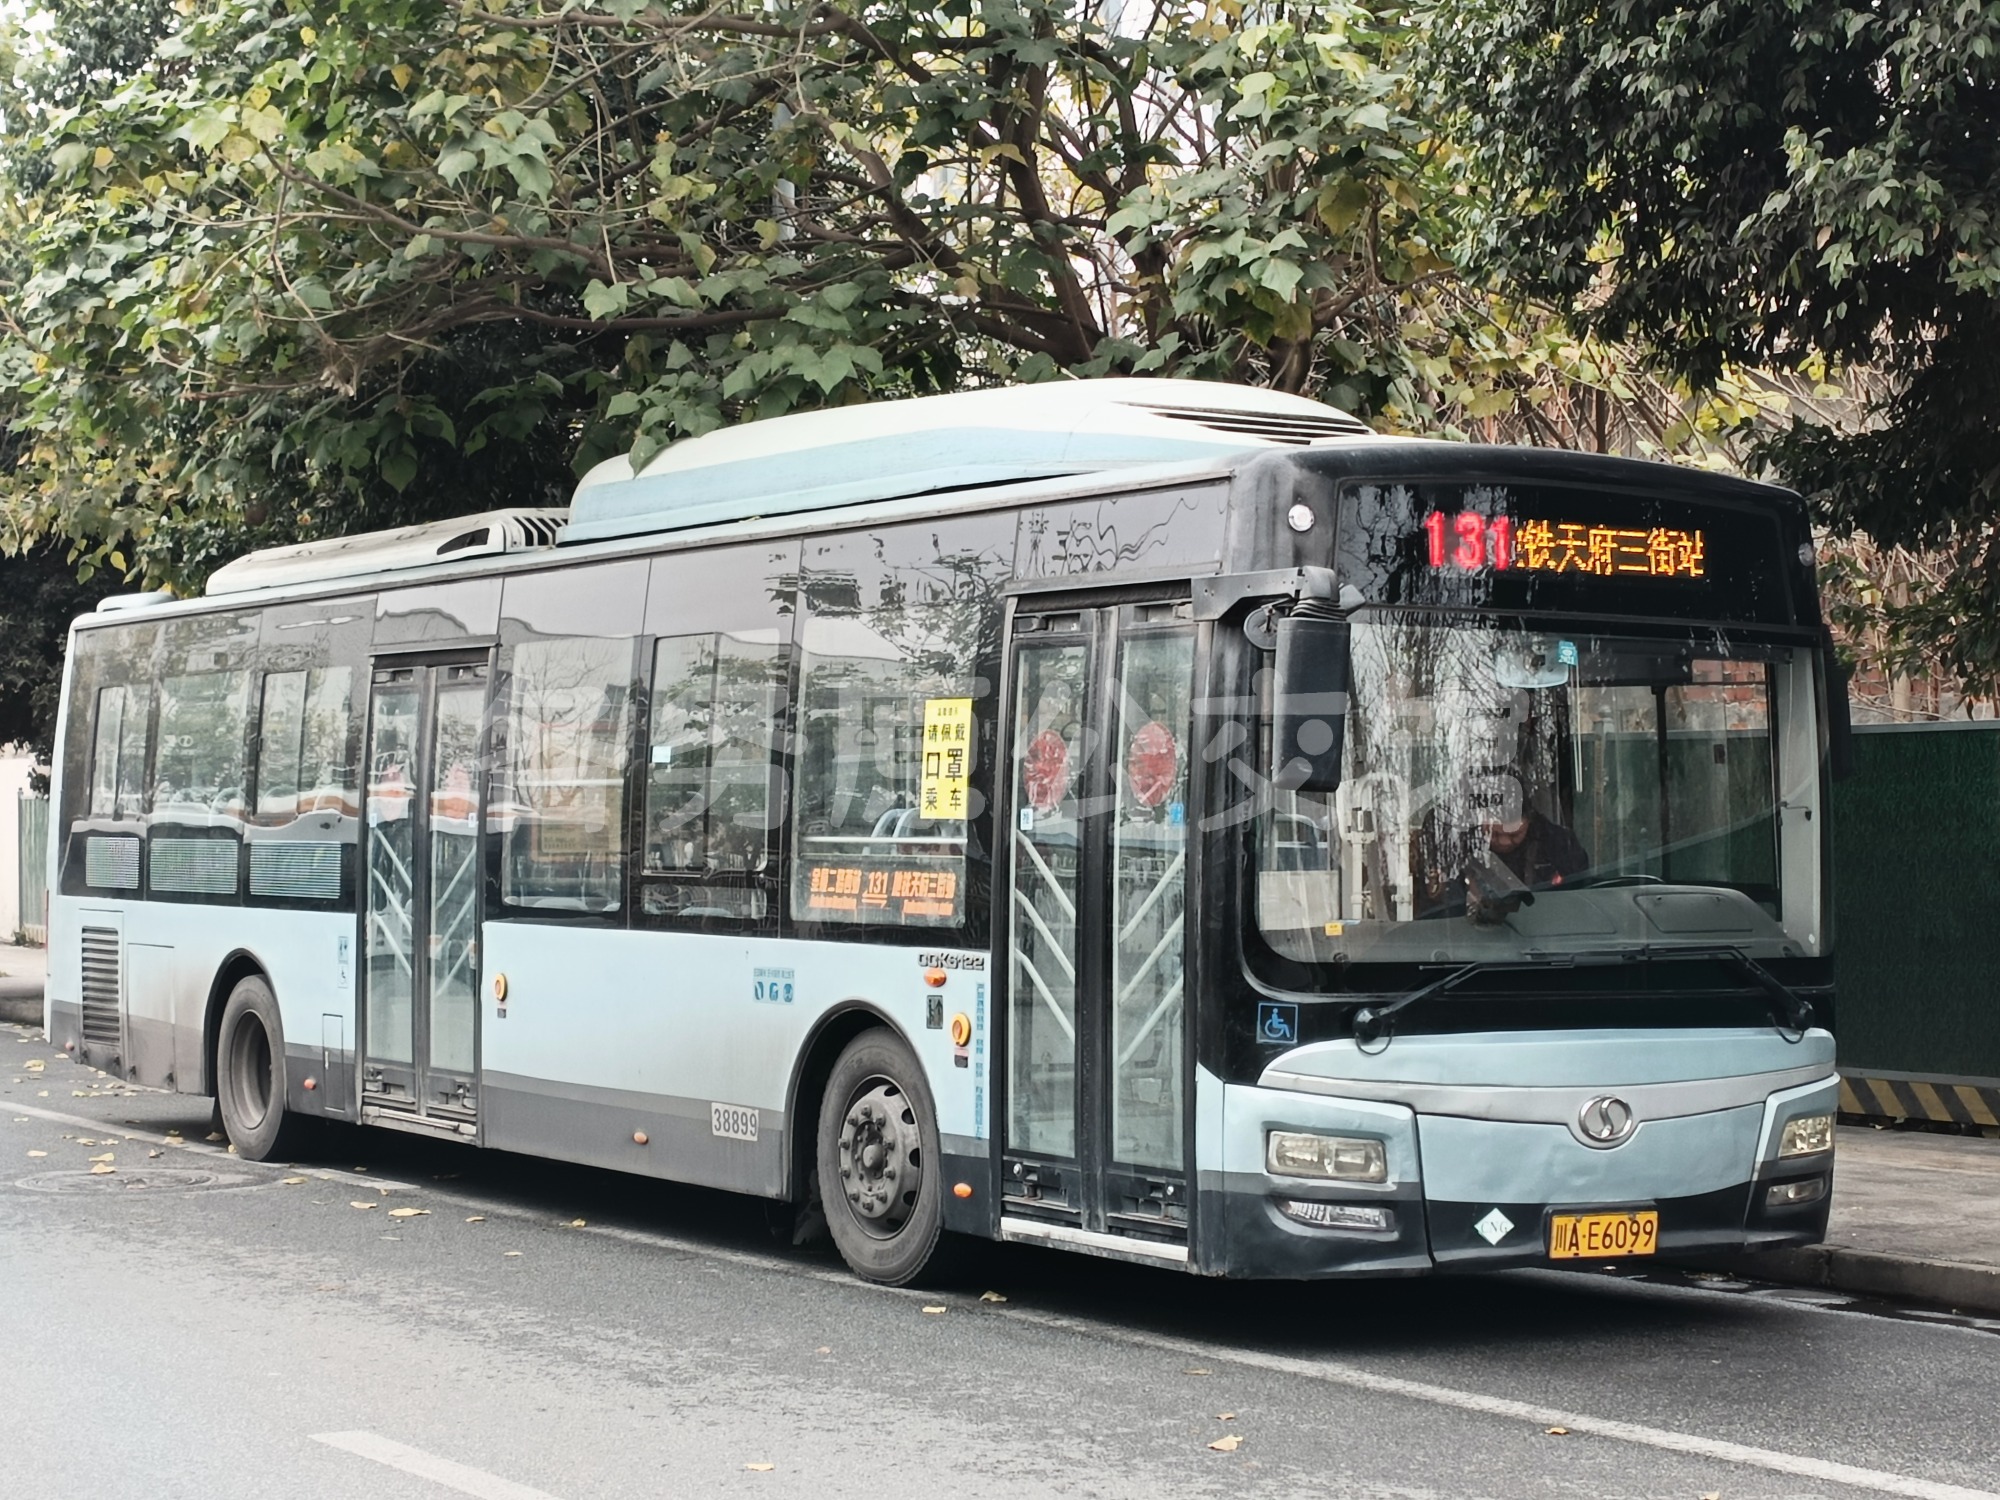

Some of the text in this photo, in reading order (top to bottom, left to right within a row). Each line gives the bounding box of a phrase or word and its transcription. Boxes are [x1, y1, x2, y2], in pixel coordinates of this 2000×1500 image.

[1424, 510, 1510, 570] 131
[1516, 519, 1704, 576] 铁天府三街站
[925, 748, 963, 782] 口罩
[925, 787, 962, 812] 乘车
[868, 871, 889, 894] 131
[713, 1108, 757, 1138] 38899
